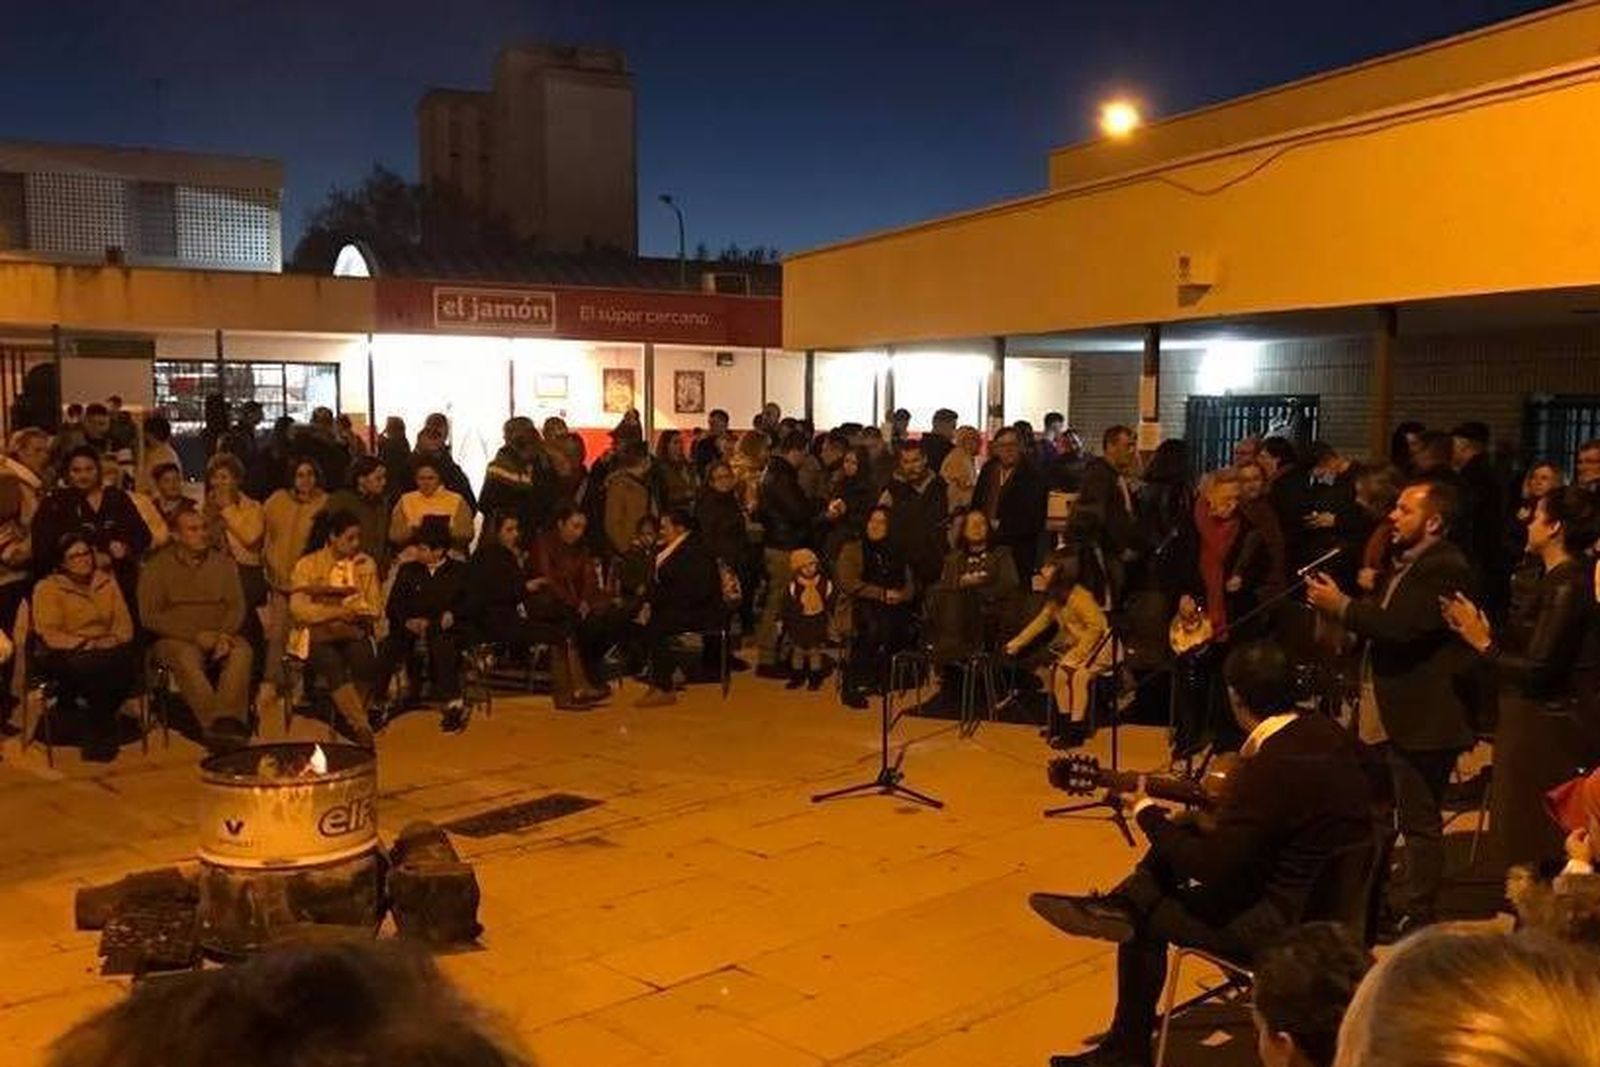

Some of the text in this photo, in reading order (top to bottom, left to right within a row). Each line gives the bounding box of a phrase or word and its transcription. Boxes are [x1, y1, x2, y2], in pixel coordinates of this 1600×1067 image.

[443, 296, 548, 321] el jamón
[579, 305, 595, 321] El
